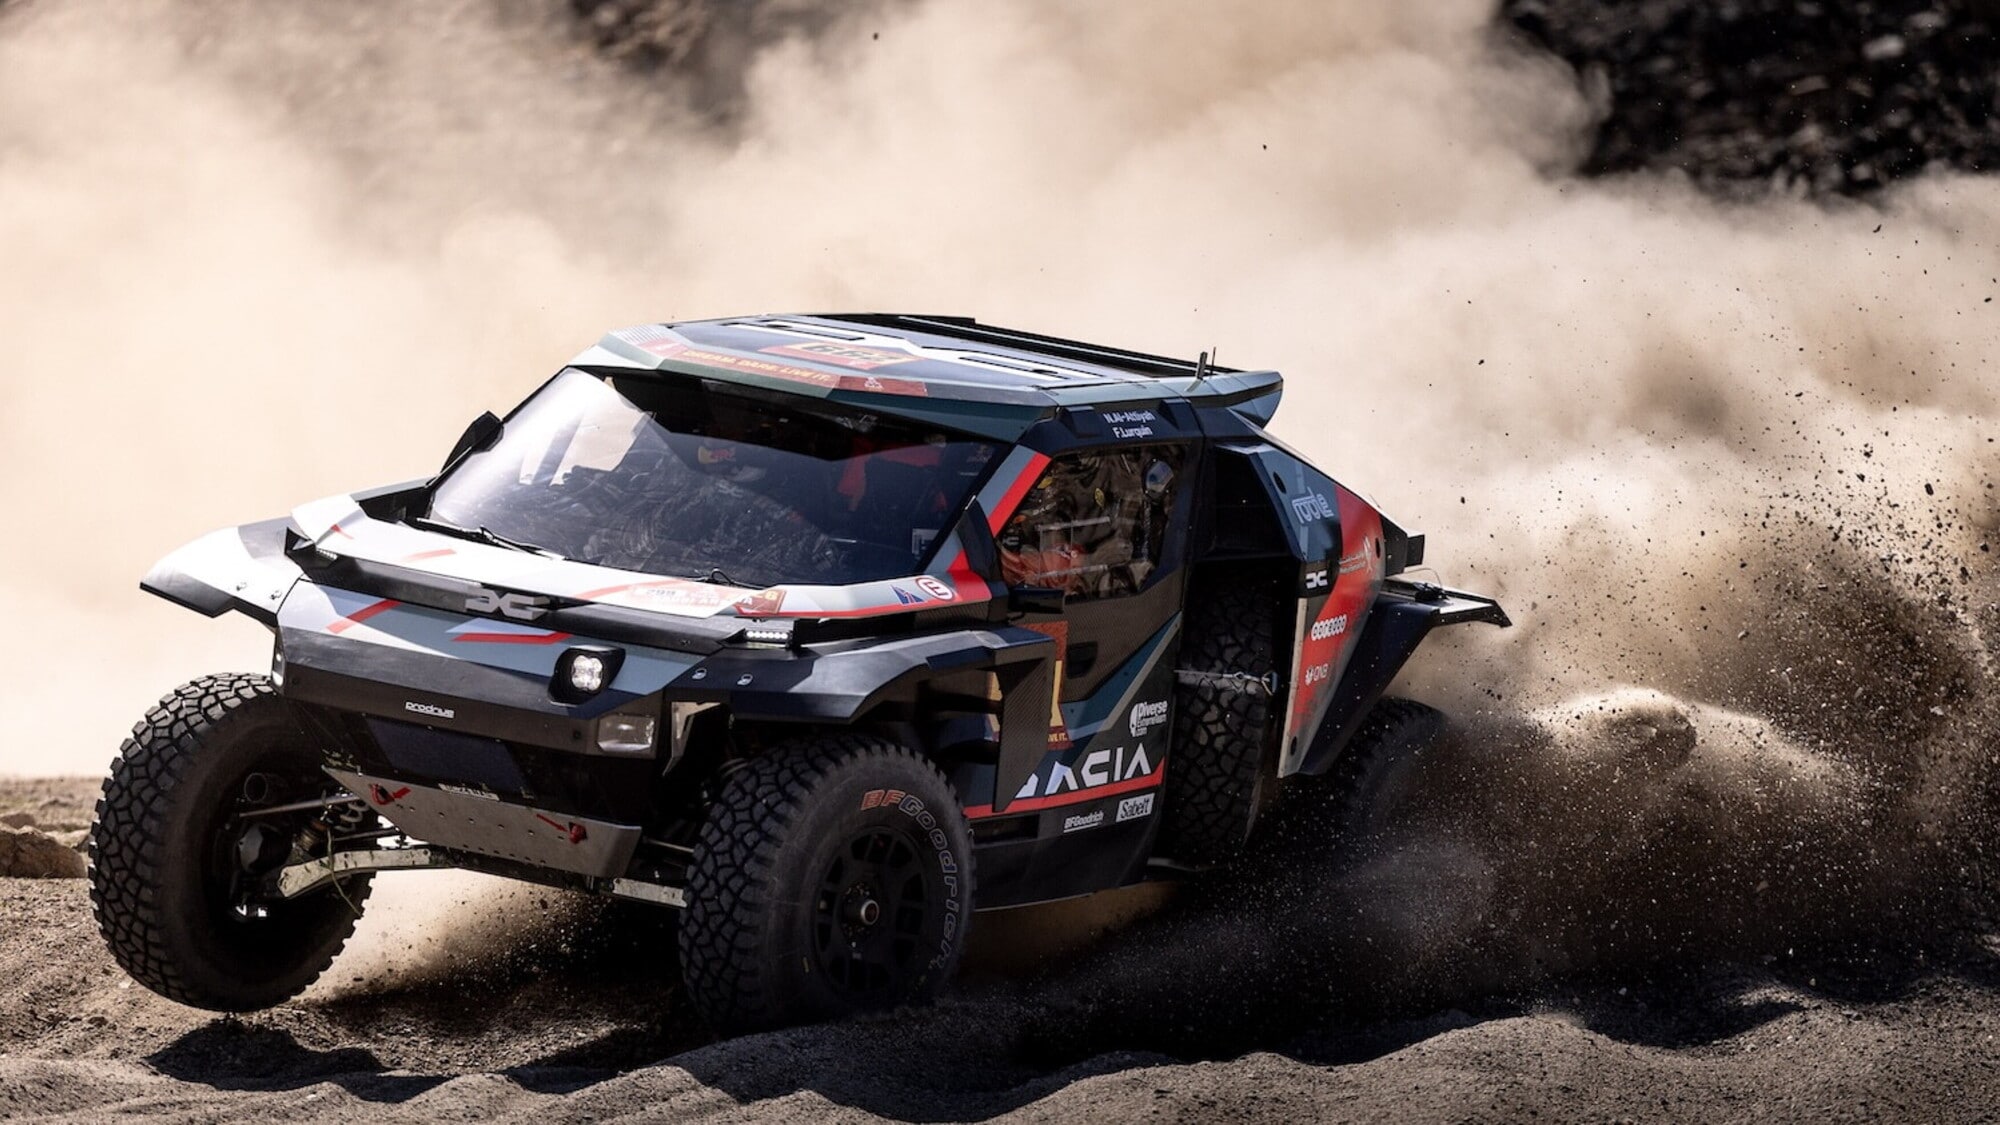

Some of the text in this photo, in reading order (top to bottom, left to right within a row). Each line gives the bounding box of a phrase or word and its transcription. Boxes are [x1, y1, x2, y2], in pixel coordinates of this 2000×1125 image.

[1064, 798, 1149, 829] BFGoodrich Sabelt
[860, 788, 959, 969] BFGoodrich
